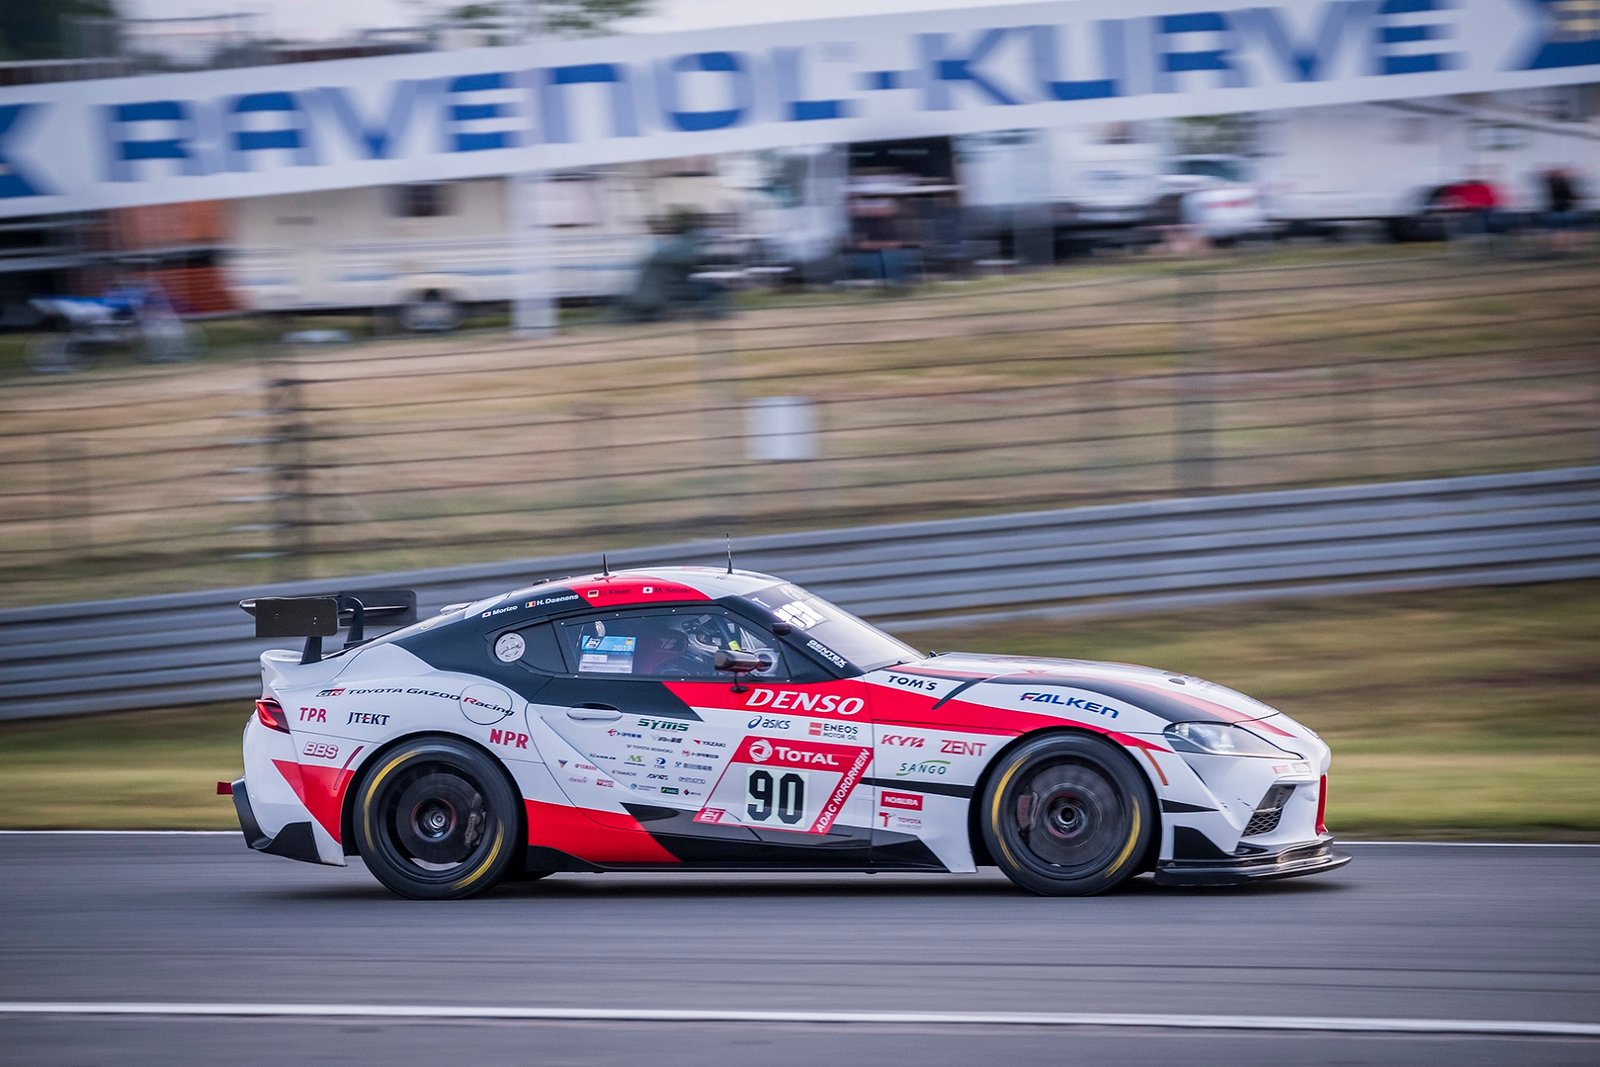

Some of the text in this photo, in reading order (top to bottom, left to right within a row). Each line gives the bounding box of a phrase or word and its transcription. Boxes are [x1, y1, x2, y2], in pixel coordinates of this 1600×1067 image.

[545, 594, 579, 605] Daenens
[492, 605, 518, 616] Morizo
[888, 675, 938, 691] TOM'S
[463, 697, 515, 717] Racing
[745, 688, 865, 715] DENSO
[1019, 692, 1119, 719] FALKEN
[299, 707, 327, 723] TPR
[347, 712, 390, 726] JTEKT
[762, 718, 791, 730] asics
[823, 723, 858, 735] ENEOS
[490, 728, 529, 750] NPR
[940, 739, 987, 757] ZENT
[303, 741, 339, 760] BBS
[775, 746, 839, 766] TOTAL
[899, 762, 947, 775] SANGO
[747, 769, 805, 825] 90
[816, 748, 871, 834] ADAC NORDRHEIN
